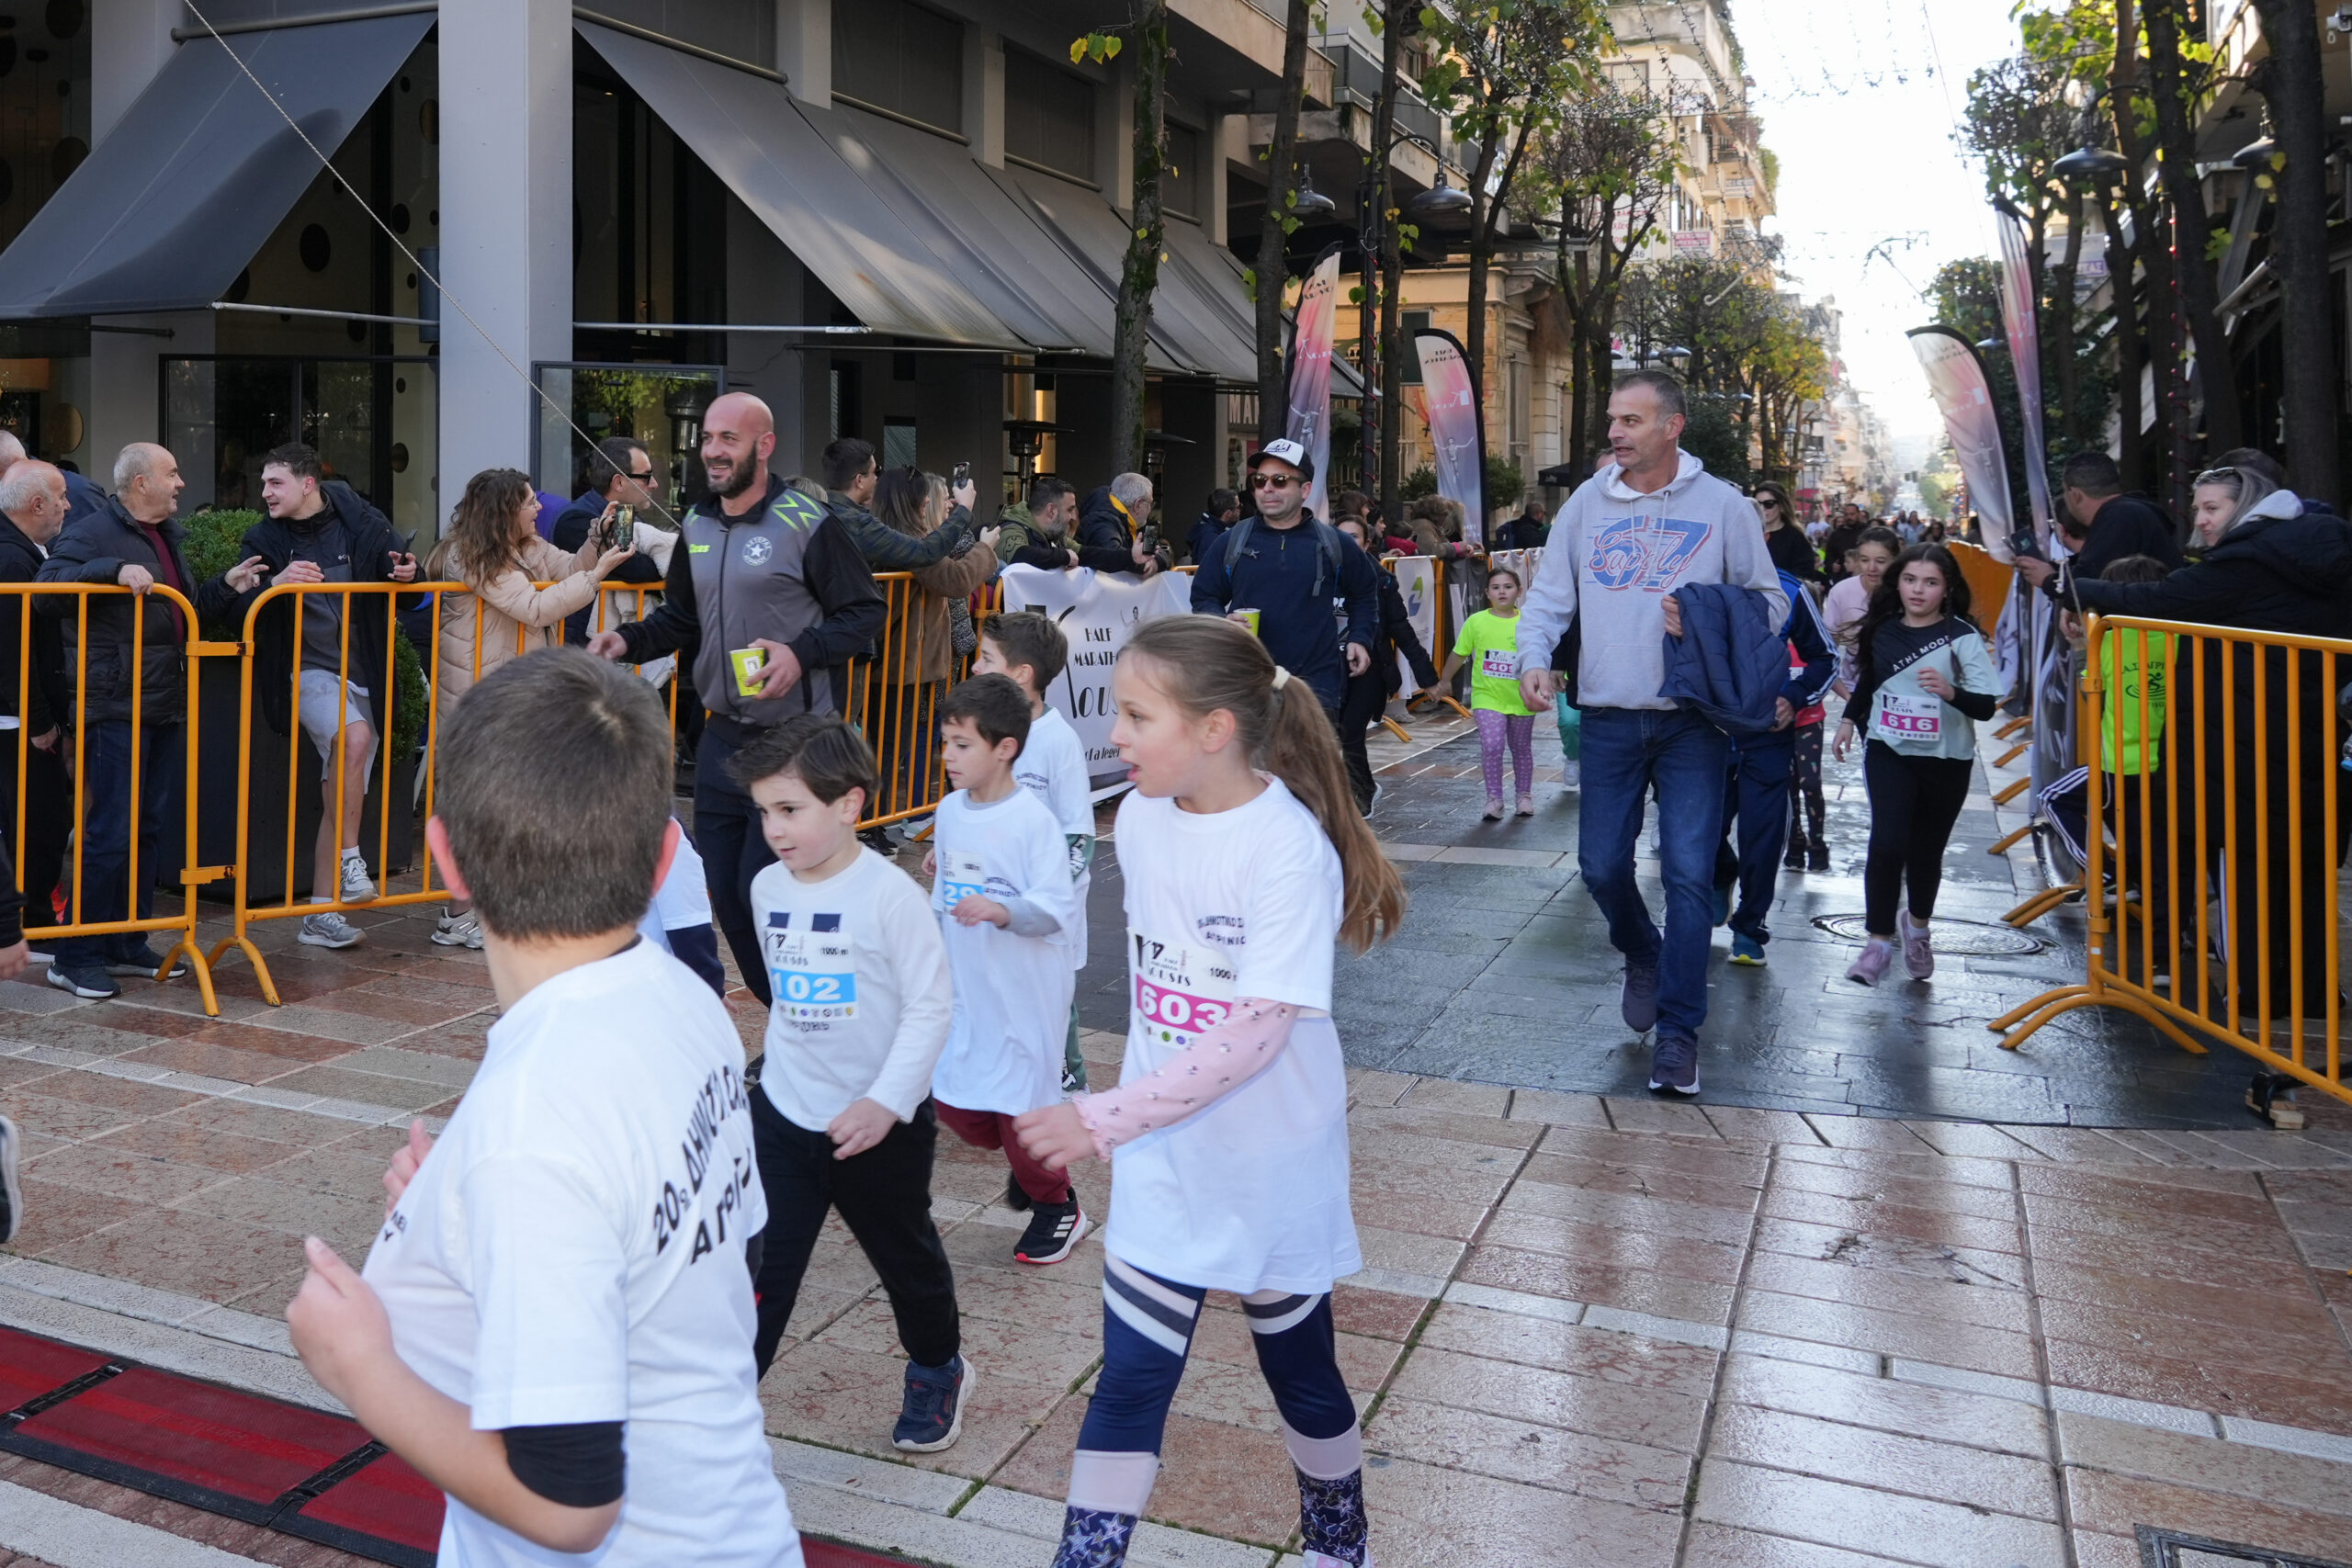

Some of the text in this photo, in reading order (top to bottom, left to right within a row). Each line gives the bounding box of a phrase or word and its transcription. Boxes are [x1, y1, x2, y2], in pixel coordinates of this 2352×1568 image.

[1085, 627, 1113, 642] HALF
[1073, 651, 1118, 667] MARATH
[1887, 715, 1934, 731] 616
[774, 972, 842, 1001] 102
[1140, 984, 1227, 1032] 603
